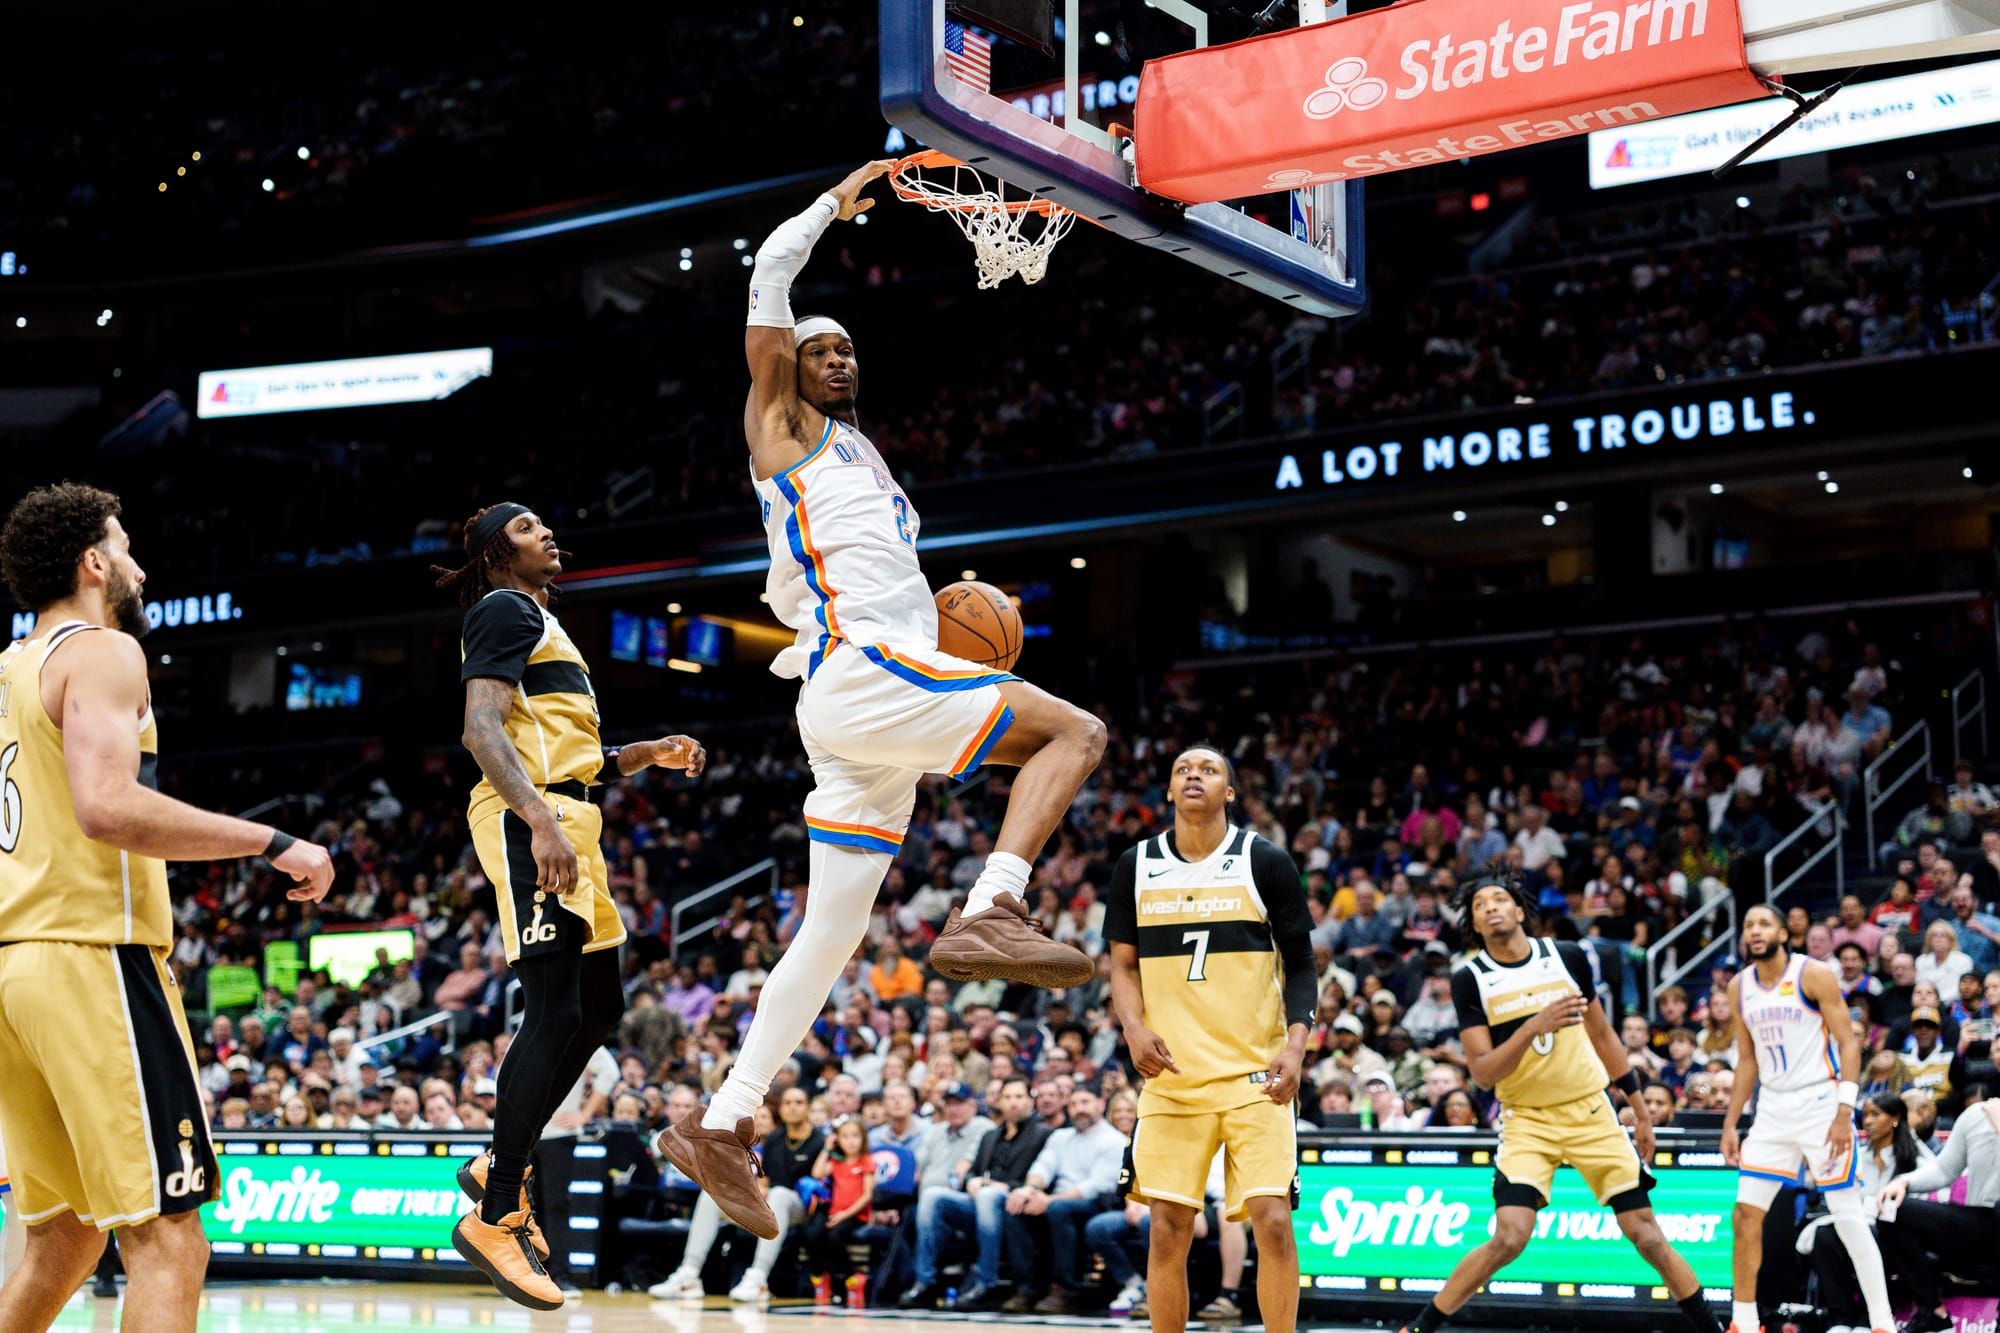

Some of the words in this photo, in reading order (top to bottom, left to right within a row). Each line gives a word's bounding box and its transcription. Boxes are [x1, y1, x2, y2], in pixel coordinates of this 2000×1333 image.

[1275, 455, 1303, 490] A
[1322, 441, 1402, 484] LOT
[1423, 422, 1551, 472] MORE
[1572, 391, 1816, 453] TROUBLE.
[891, 492, 914, 547] 2
[143, 592, 242, 629] OUBLE.
[1141, 893, 1242, 917] washington
[1182, 930, 1210, 982] 7
[1765, 1044, 1788, 1073] 11
[213, 1165, 341, 1235] Sprite
[1309, 1185, 1471, 1258] Sprite
